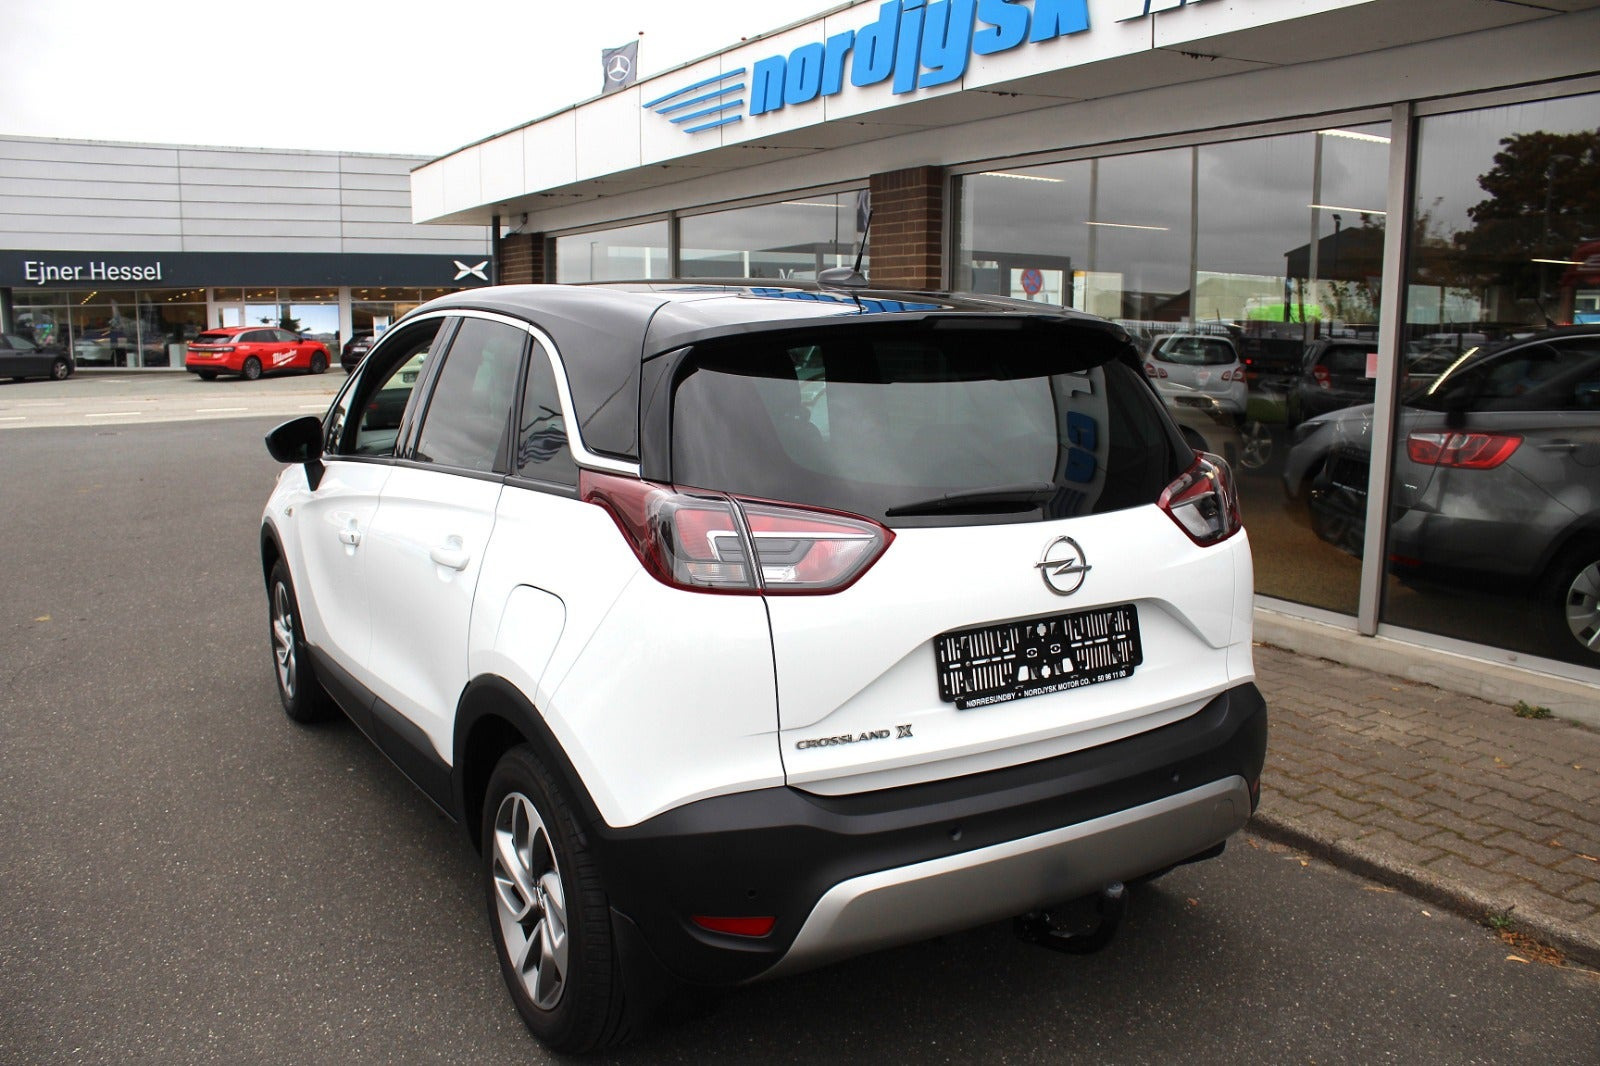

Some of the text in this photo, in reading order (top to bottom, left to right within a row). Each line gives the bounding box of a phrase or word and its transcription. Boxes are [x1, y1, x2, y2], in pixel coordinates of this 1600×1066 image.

[24, 261, 162, 285] Ejner Hessel
[966, 692, 1016, 708] NØRRESUNDBY
[1023, 685, 1058, 697] NORDJYSK
[1058, 679, 1080, 692] MOTOR
[1080, 678, 1091, 686] CO.
[796, 724, 914, 750] CROSSLAND X
